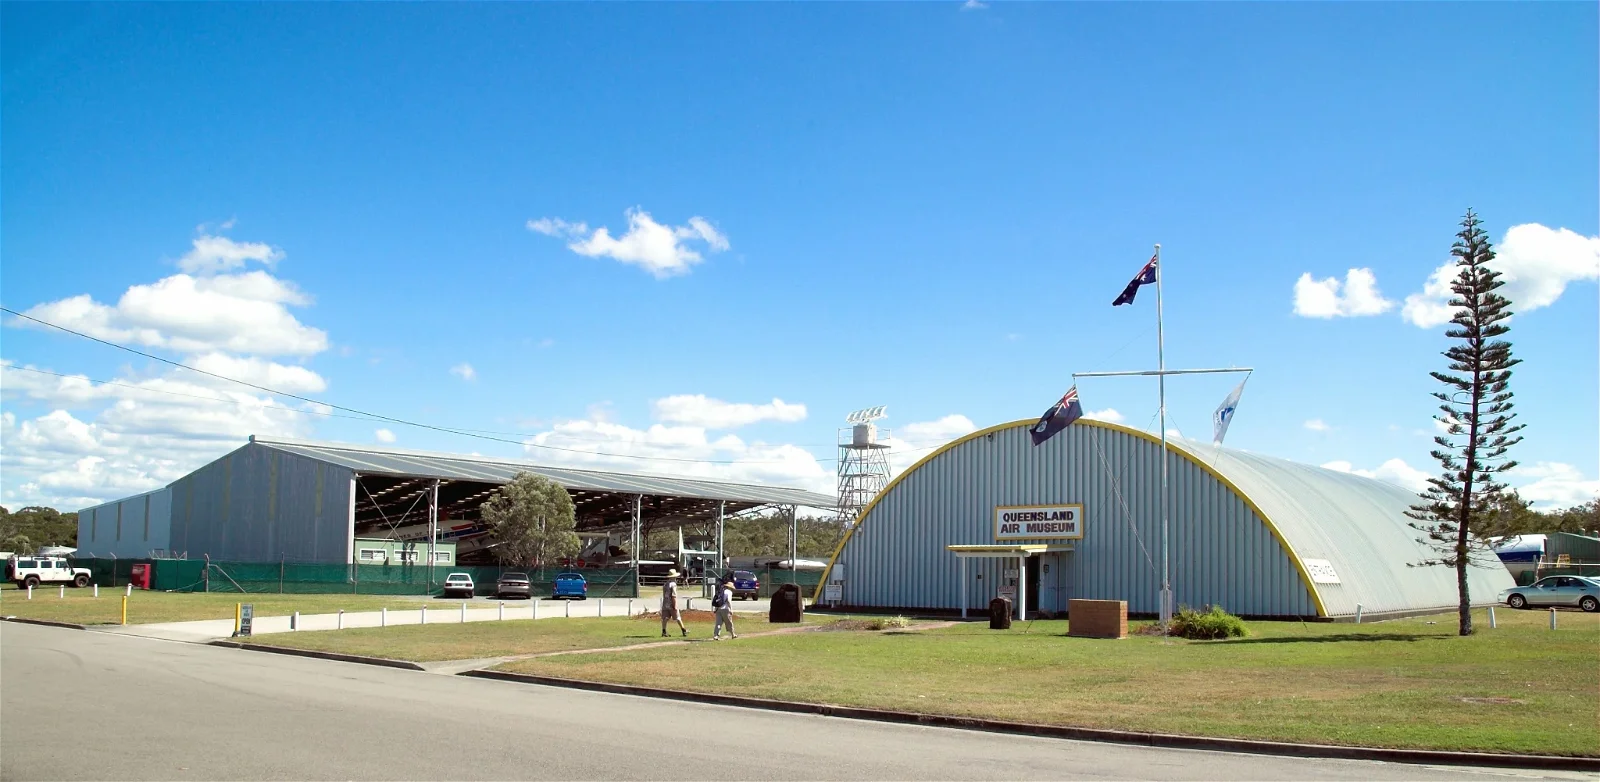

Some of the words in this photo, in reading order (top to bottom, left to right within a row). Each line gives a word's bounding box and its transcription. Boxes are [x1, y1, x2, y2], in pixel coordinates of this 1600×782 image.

[1003, 511, 1074, 522] QUEENSLAND
[1001, 523, 1020, 534] AIR
[1026, 522, 1075, 533] MUSEUM
